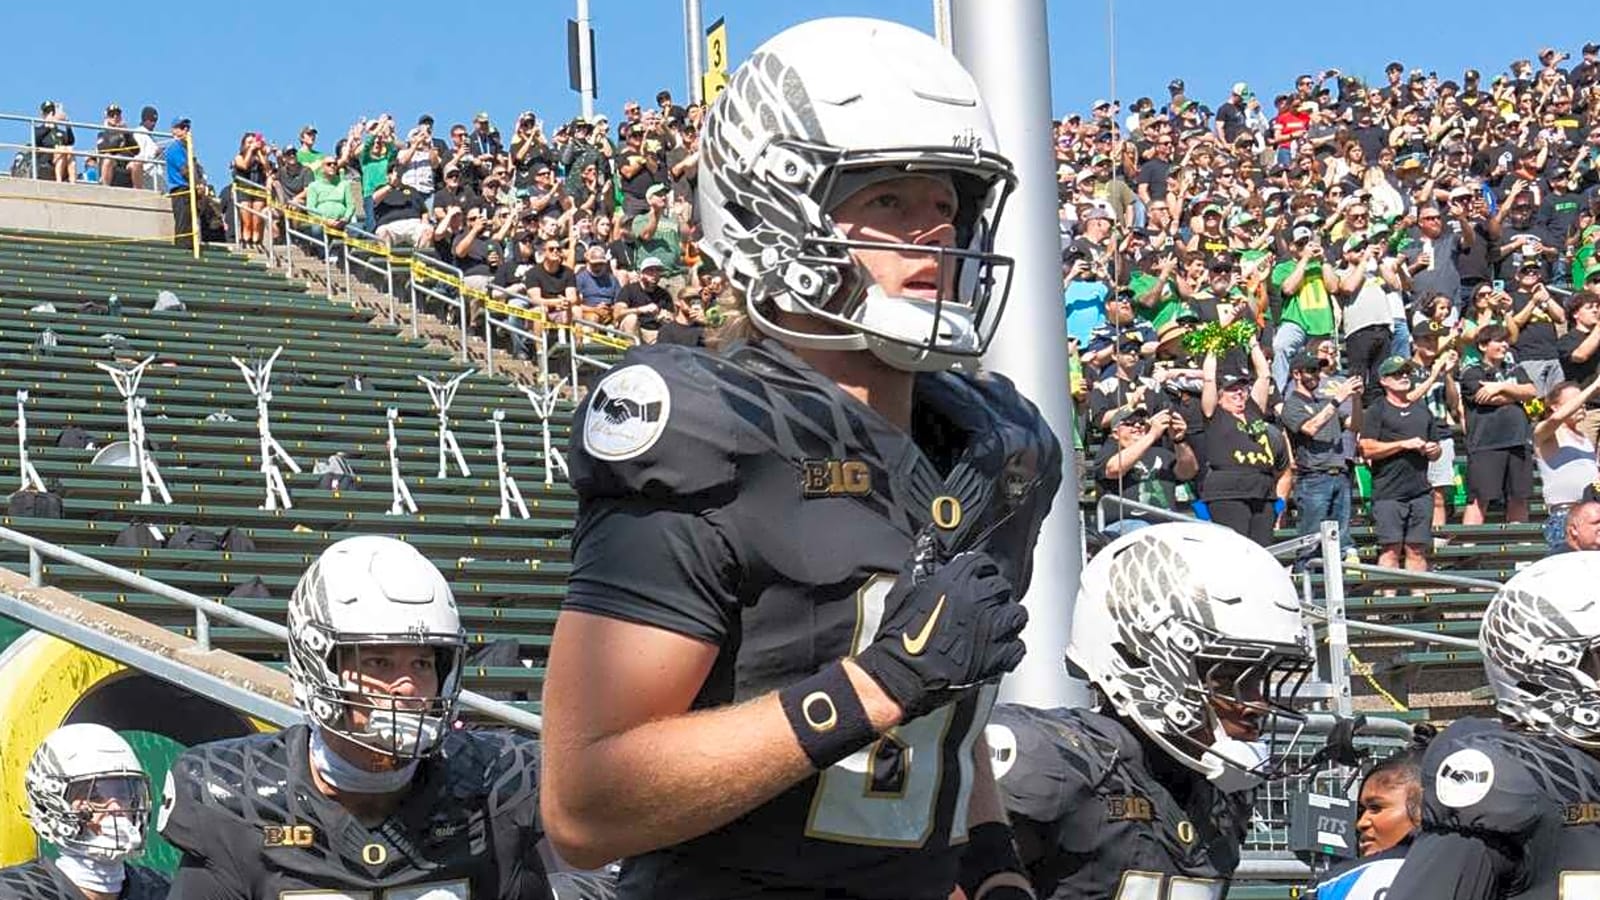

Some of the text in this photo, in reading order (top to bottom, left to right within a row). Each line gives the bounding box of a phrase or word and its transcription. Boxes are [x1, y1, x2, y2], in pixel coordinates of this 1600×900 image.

[713, 38, 721, 68] 3
[932, 495, 961, 529] O
[801, 690, 838, 732] O
[1317, 815, 1348, 835] RTS
[362, 843, 387, 865] O
